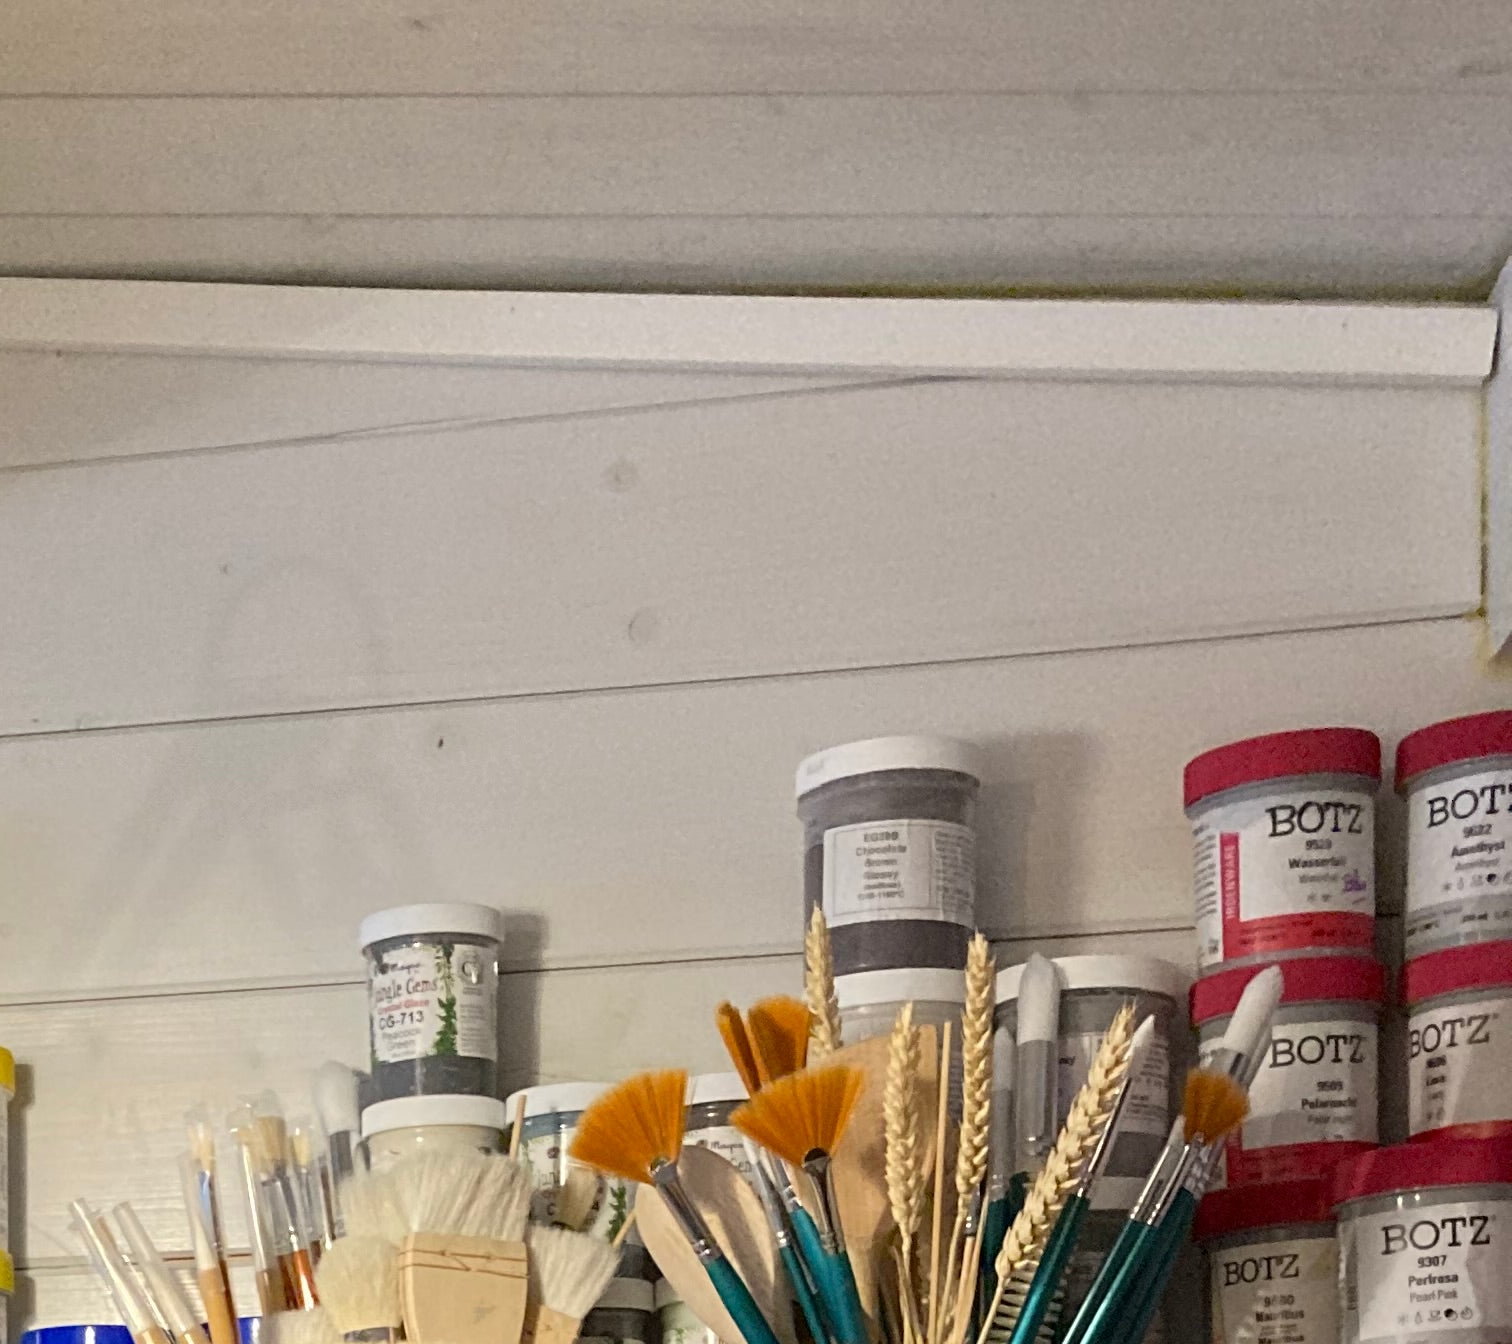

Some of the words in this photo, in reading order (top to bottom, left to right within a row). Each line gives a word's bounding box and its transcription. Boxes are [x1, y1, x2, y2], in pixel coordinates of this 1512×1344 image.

[1265, 801, 1363, 838] BOTZ
[1426, 784, 1512, 829] BOT
[378, 1010, 425, 1030] CG-713
[1410, 1015, 1492, 1060] BOTZ
[1269, 1034, 1367, 1069] BOTZ
[1381, 1215, 1491, 1256] BOTZ
[1224, 1253, 1299, 1287] BOTZ
[1417, 1254, 1448, 1269] 9307
